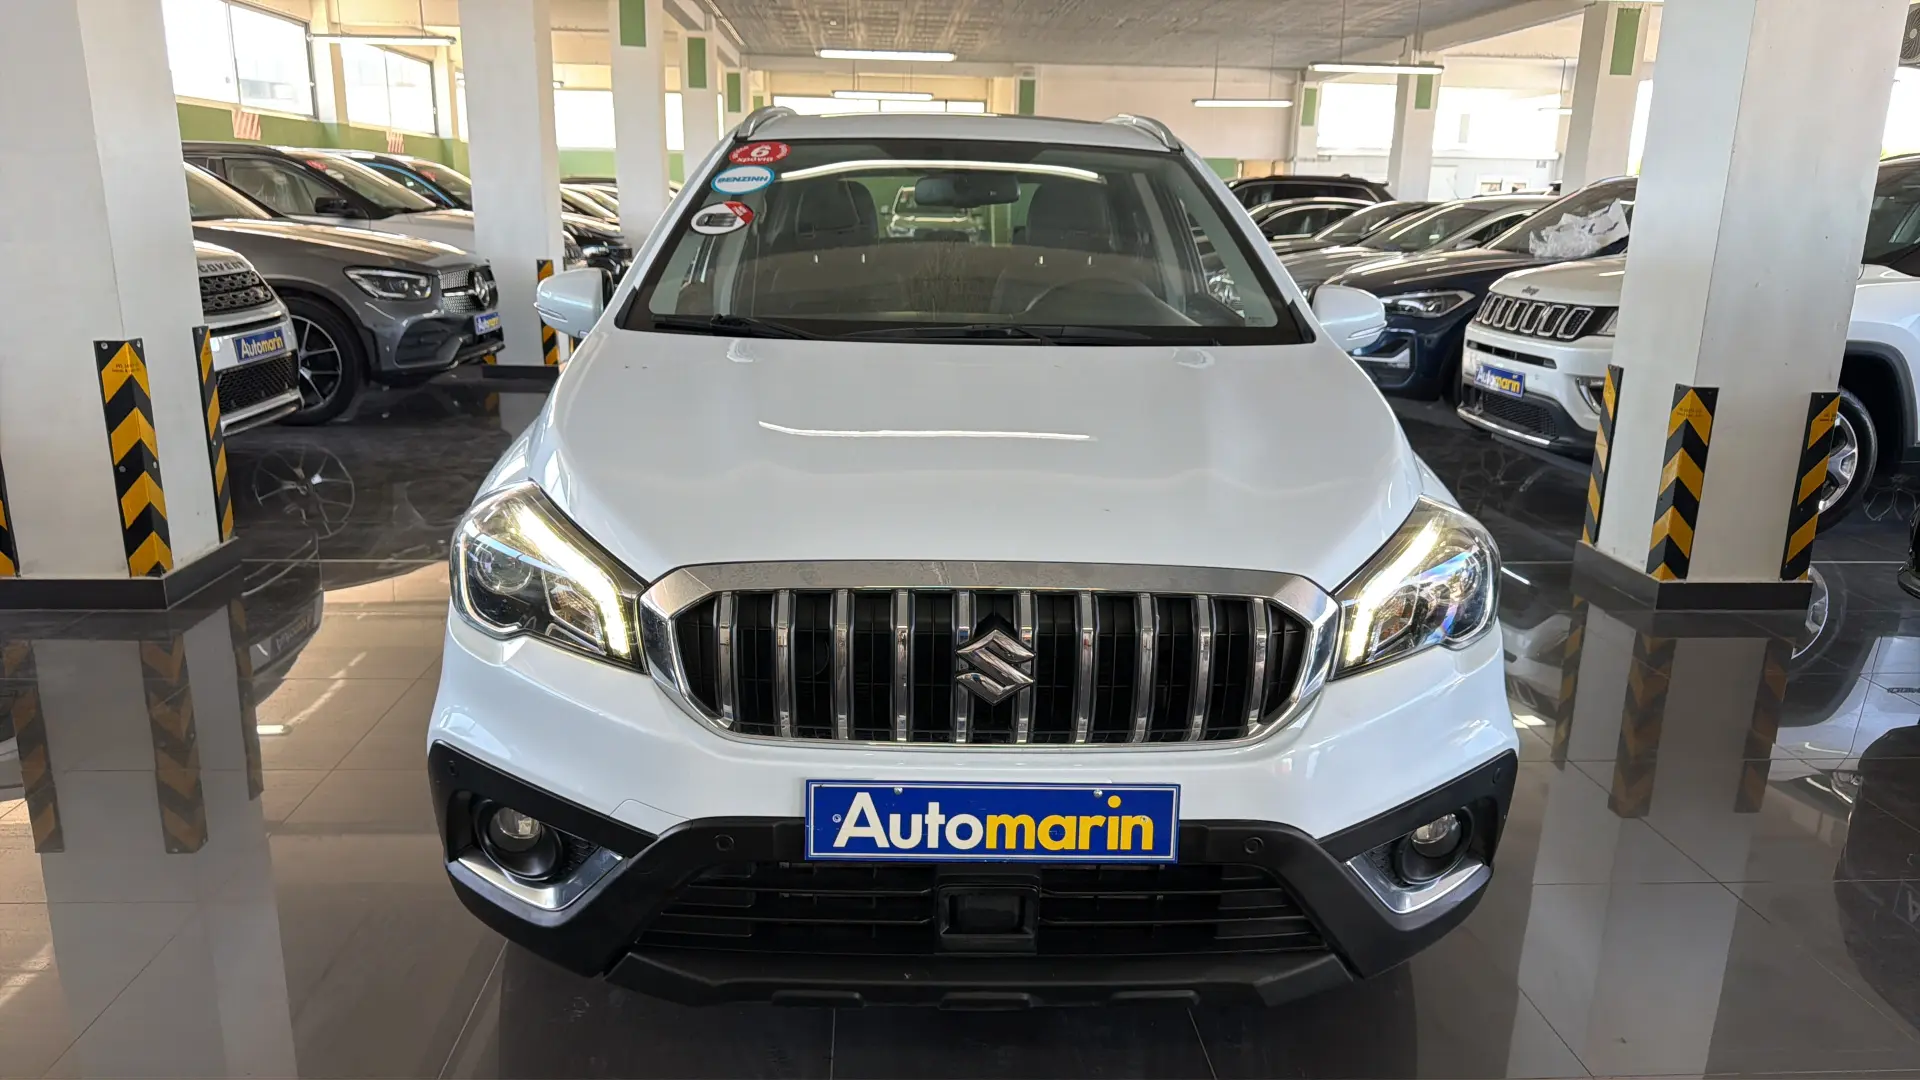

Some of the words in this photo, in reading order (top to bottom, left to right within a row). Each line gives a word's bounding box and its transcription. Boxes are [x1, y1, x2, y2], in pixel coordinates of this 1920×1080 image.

[751, 144, 772, 157] 6
[241, 331, 284, 359] Automarin
[1475, 366, 1521, 394] Automarin
[833, 791, 1154, 851] Automarin
